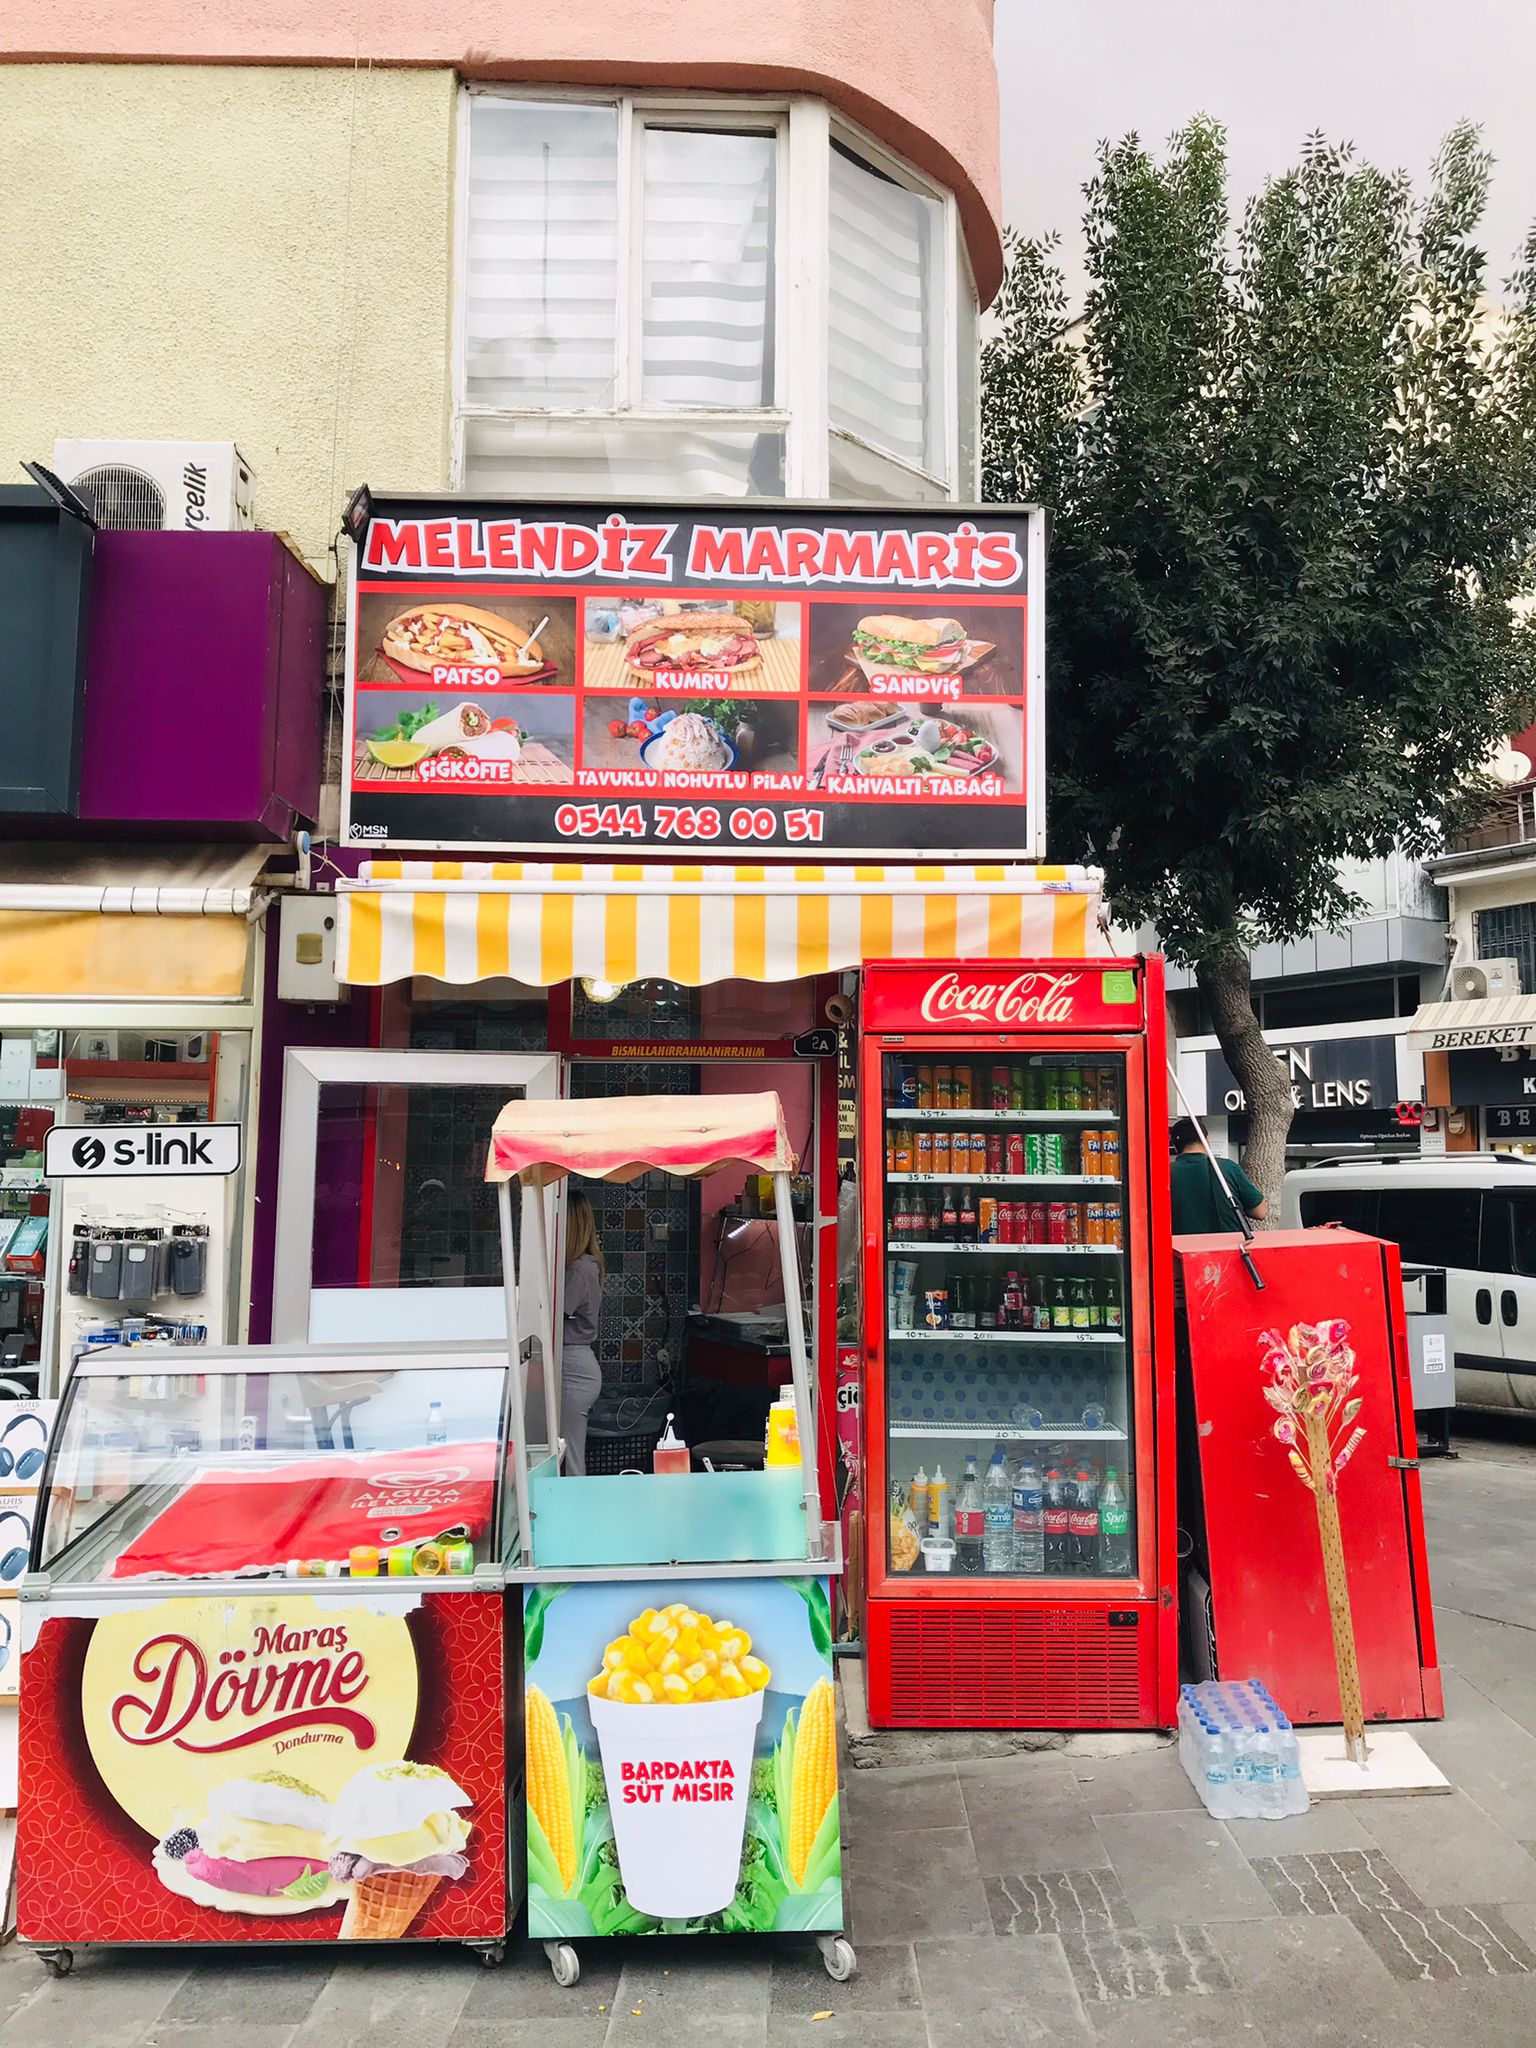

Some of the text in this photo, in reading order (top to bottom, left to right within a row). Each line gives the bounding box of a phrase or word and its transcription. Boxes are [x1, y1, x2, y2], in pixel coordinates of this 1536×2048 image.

[362, 513, 1023, 588] MELENDİZ MARMARİS
[433, 667, 500, 685] PATSO
[656, 671, 729, 690] KUMRU
[577, 771, 657, 787] TAVUKLU
[664, 772, 747, 789] NOHUTLU
[828, 773, 1002, 796] KAHVALTI TABAĞI
[363, 825, 388, 834] MSN
[555, 803, 824, 841] 0544 768 00 51
[921, 972, 1083, 1022] Coca-Cola
[1432, 1026, 1532, 1048] BEREKET
[1312, 1079, 1371, 1108] LENS
[113, 1132, 213, 1165] s-link
[353, 1488, 461, 1501] ALGIDA
[385, 1497, 460, 1506] KAZAN
[253, 1624, 348, 1657] Maraş
[112, 1633, 370, 1746] Dövme
[273, 1730, 345, 1756] Dondurma
[621, 1759, 735, 1781] BARDAKTA
[623, 1778, 734, 1803] SÜT MISIR
